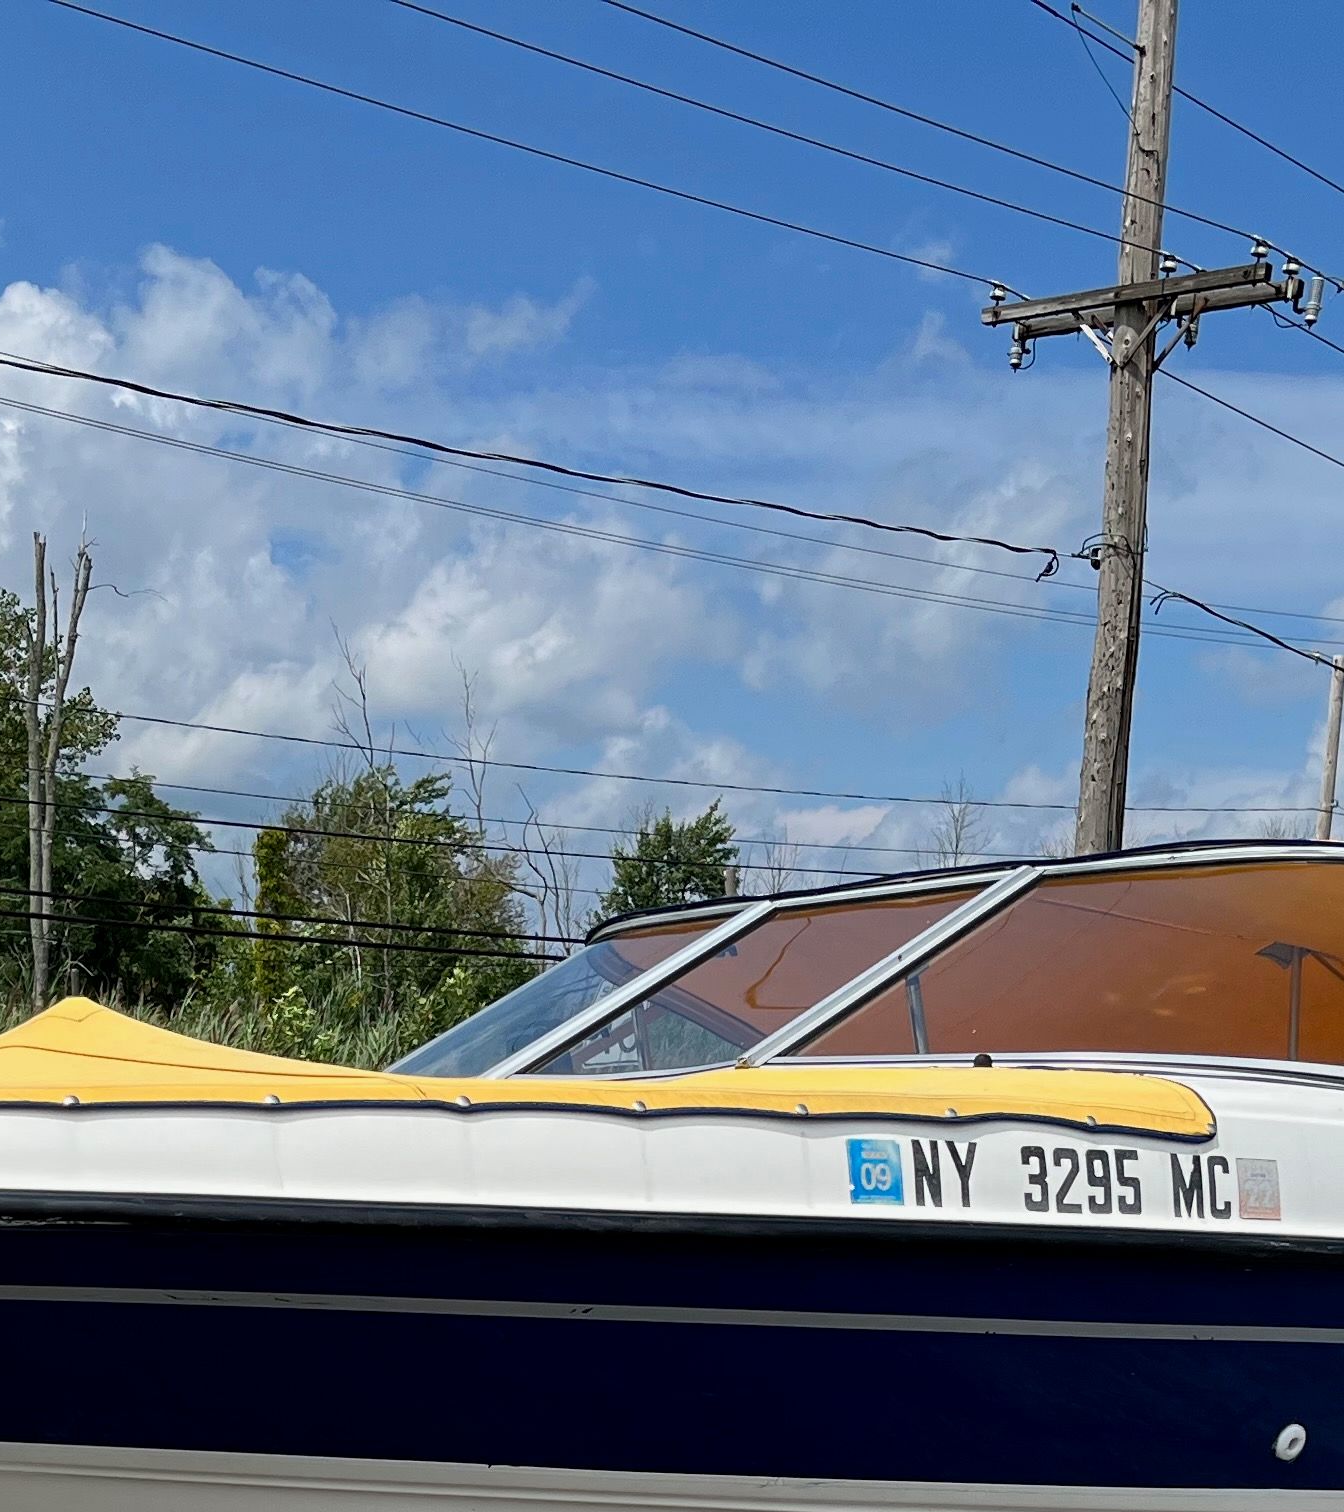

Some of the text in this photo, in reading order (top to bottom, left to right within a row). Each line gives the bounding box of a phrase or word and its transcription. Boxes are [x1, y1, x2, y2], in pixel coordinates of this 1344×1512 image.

[860, 1162, 892, 1192] 09
[911, 1139, 977, 1208] NY
[1020, 1145, 1142, 1215] 3295
[1170, 1152, 1232, 1219] MC
